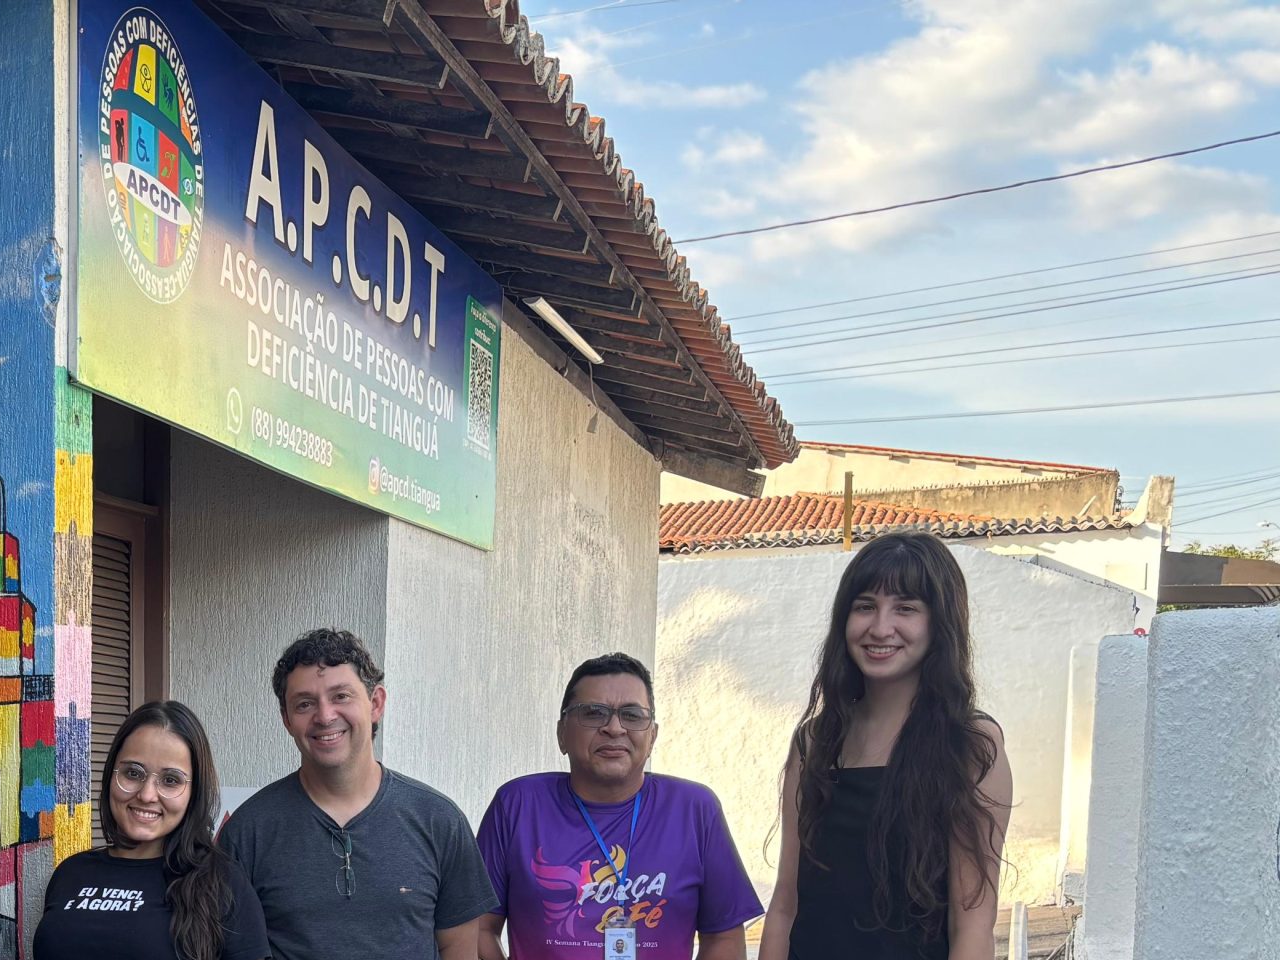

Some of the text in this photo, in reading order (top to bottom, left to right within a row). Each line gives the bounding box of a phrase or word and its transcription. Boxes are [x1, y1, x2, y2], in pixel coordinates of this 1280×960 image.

[125, 16, 148, 44] COM
[101, 30, 127, 135] PESSOAS
[149, 19, 201, 156] DEFICIÊNCIAS
[102, 144, 113, 179] DE
[195, 165, 203, 197] DE
[126, 168, 181, 221] APCDT
[245, 99, 446, 348] A.P.C.D.T
[220, 243, 454, 422] ASSOCIAÇÃO DE PESSOAS COM
[248, 320, 439, 460] DEFICIÊNCIA DE TIANGUÁ
[251, 406, 333, 467] (88) 994238883
[380, 466, 441, 513] @apcd.tiangua
[63, 898, 144, 911] E AGORA?
[78, 887, 143, 901] EU VENCI,
[578, 872, 667, 905] FORÇA
[629, 898, 668, 928] Fé
[582, 940, 605, 948] Tiangu
